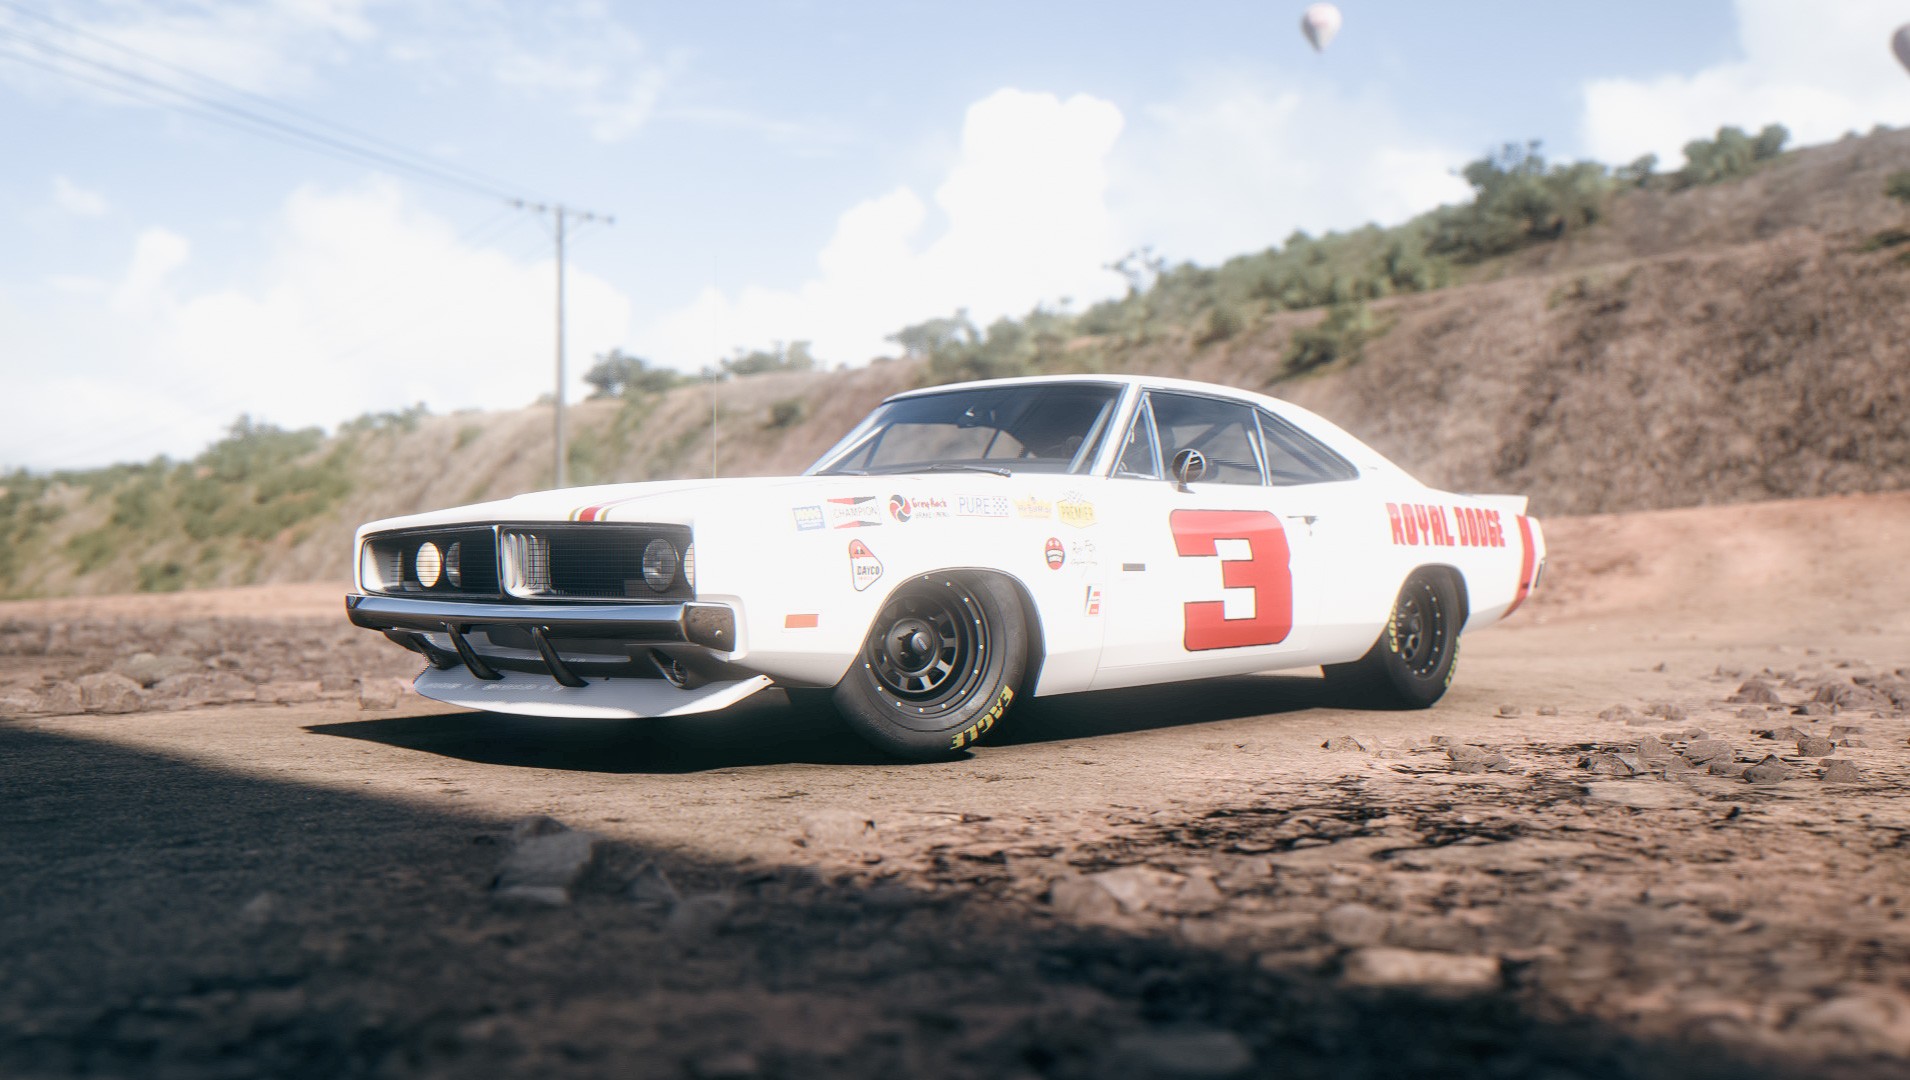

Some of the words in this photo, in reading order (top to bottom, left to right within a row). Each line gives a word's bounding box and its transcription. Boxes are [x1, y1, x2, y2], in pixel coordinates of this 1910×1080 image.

[958, 496, 991, 515] PURE
[1386, 502, 1455, 546] ROYAL
[1453, 506, 1506, 547] DODGE
[1169, 508, 1293, 652] 3
[949, 684, 1014, 750] EAGLE
